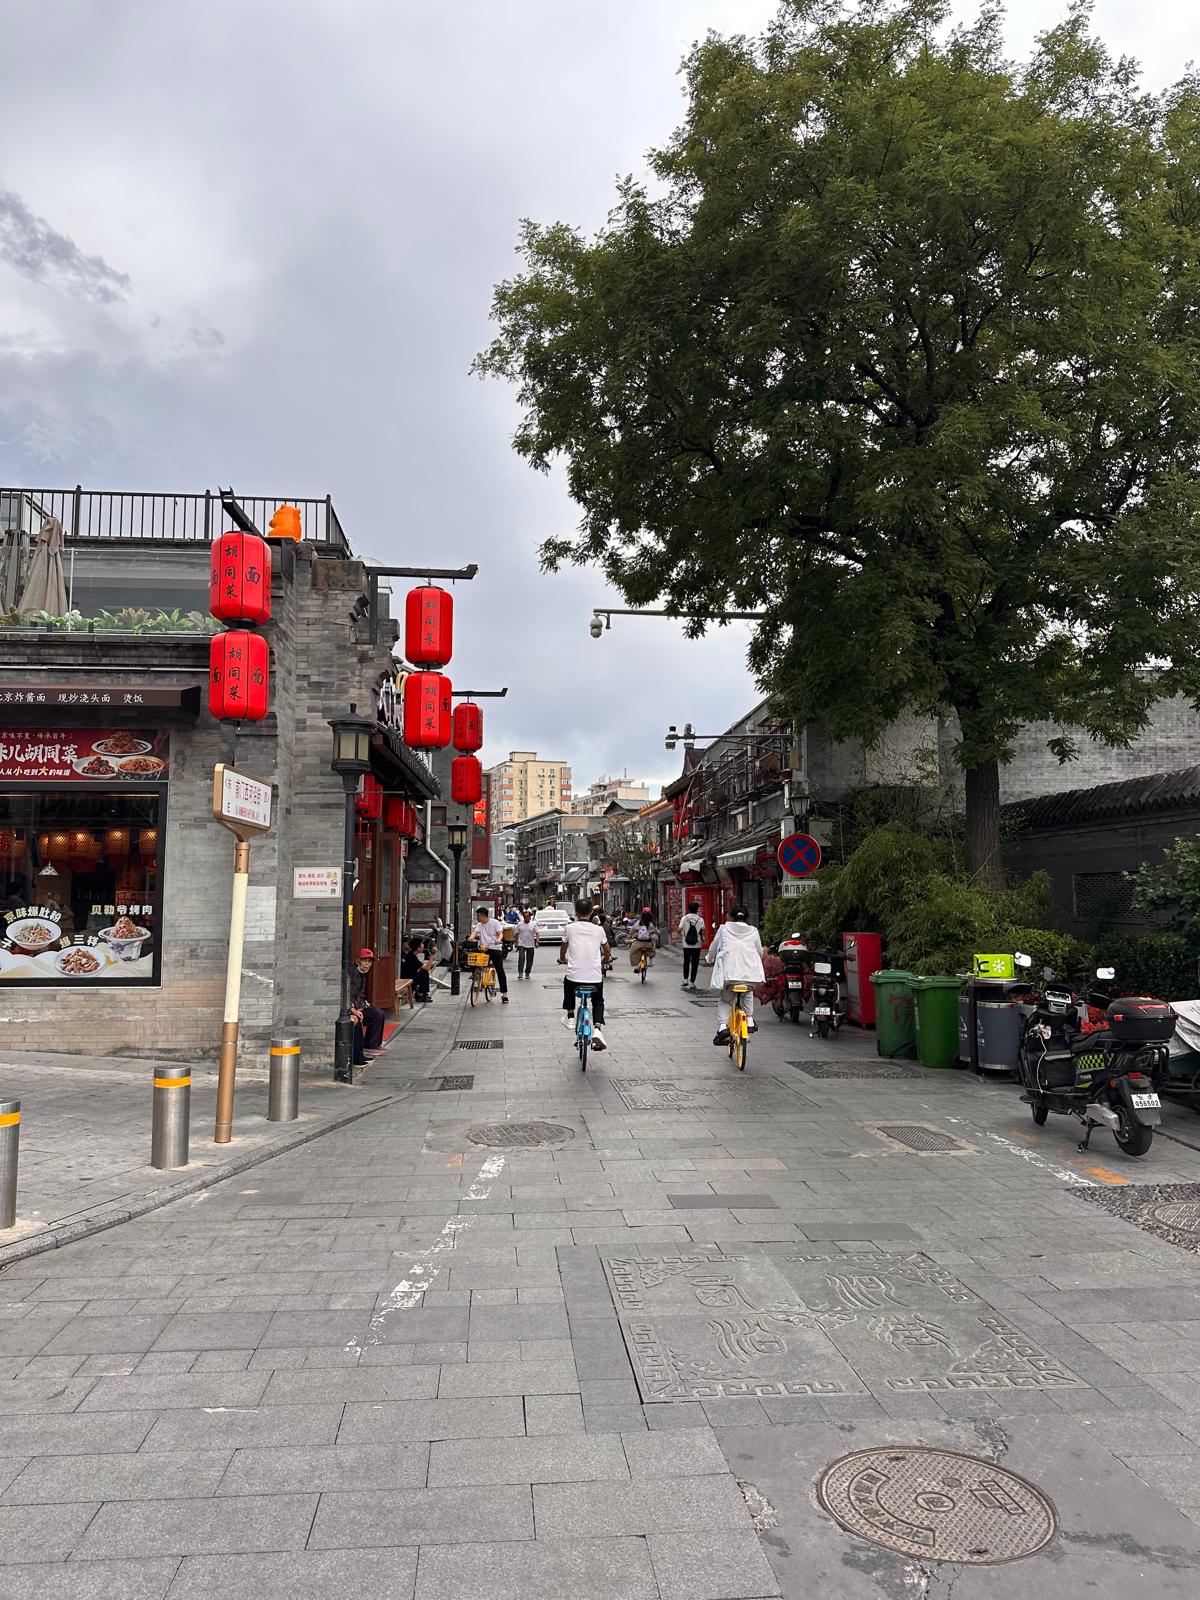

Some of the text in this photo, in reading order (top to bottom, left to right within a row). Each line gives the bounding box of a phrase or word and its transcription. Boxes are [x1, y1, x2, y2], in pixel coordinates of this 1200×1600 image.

[224, 544, 239, 599] 胡同菜
[245, 566, 261, 586] 面
[424, 599, 438, 646] 胡同菜
[212, 667, 222, 684] 面
[228, 647, 243, 701] 胡同菜
[251, 667, 264, 686] 面
[57, 692, 111, 704] 现炒浇头面
[123, 692, 144, 705] 烫饭
[424, 685, 438, 730] 胡同菜
[91, 904, 153, 915] 贝勒爷烤肉
[59, 934, 99, 949] 爆三样
